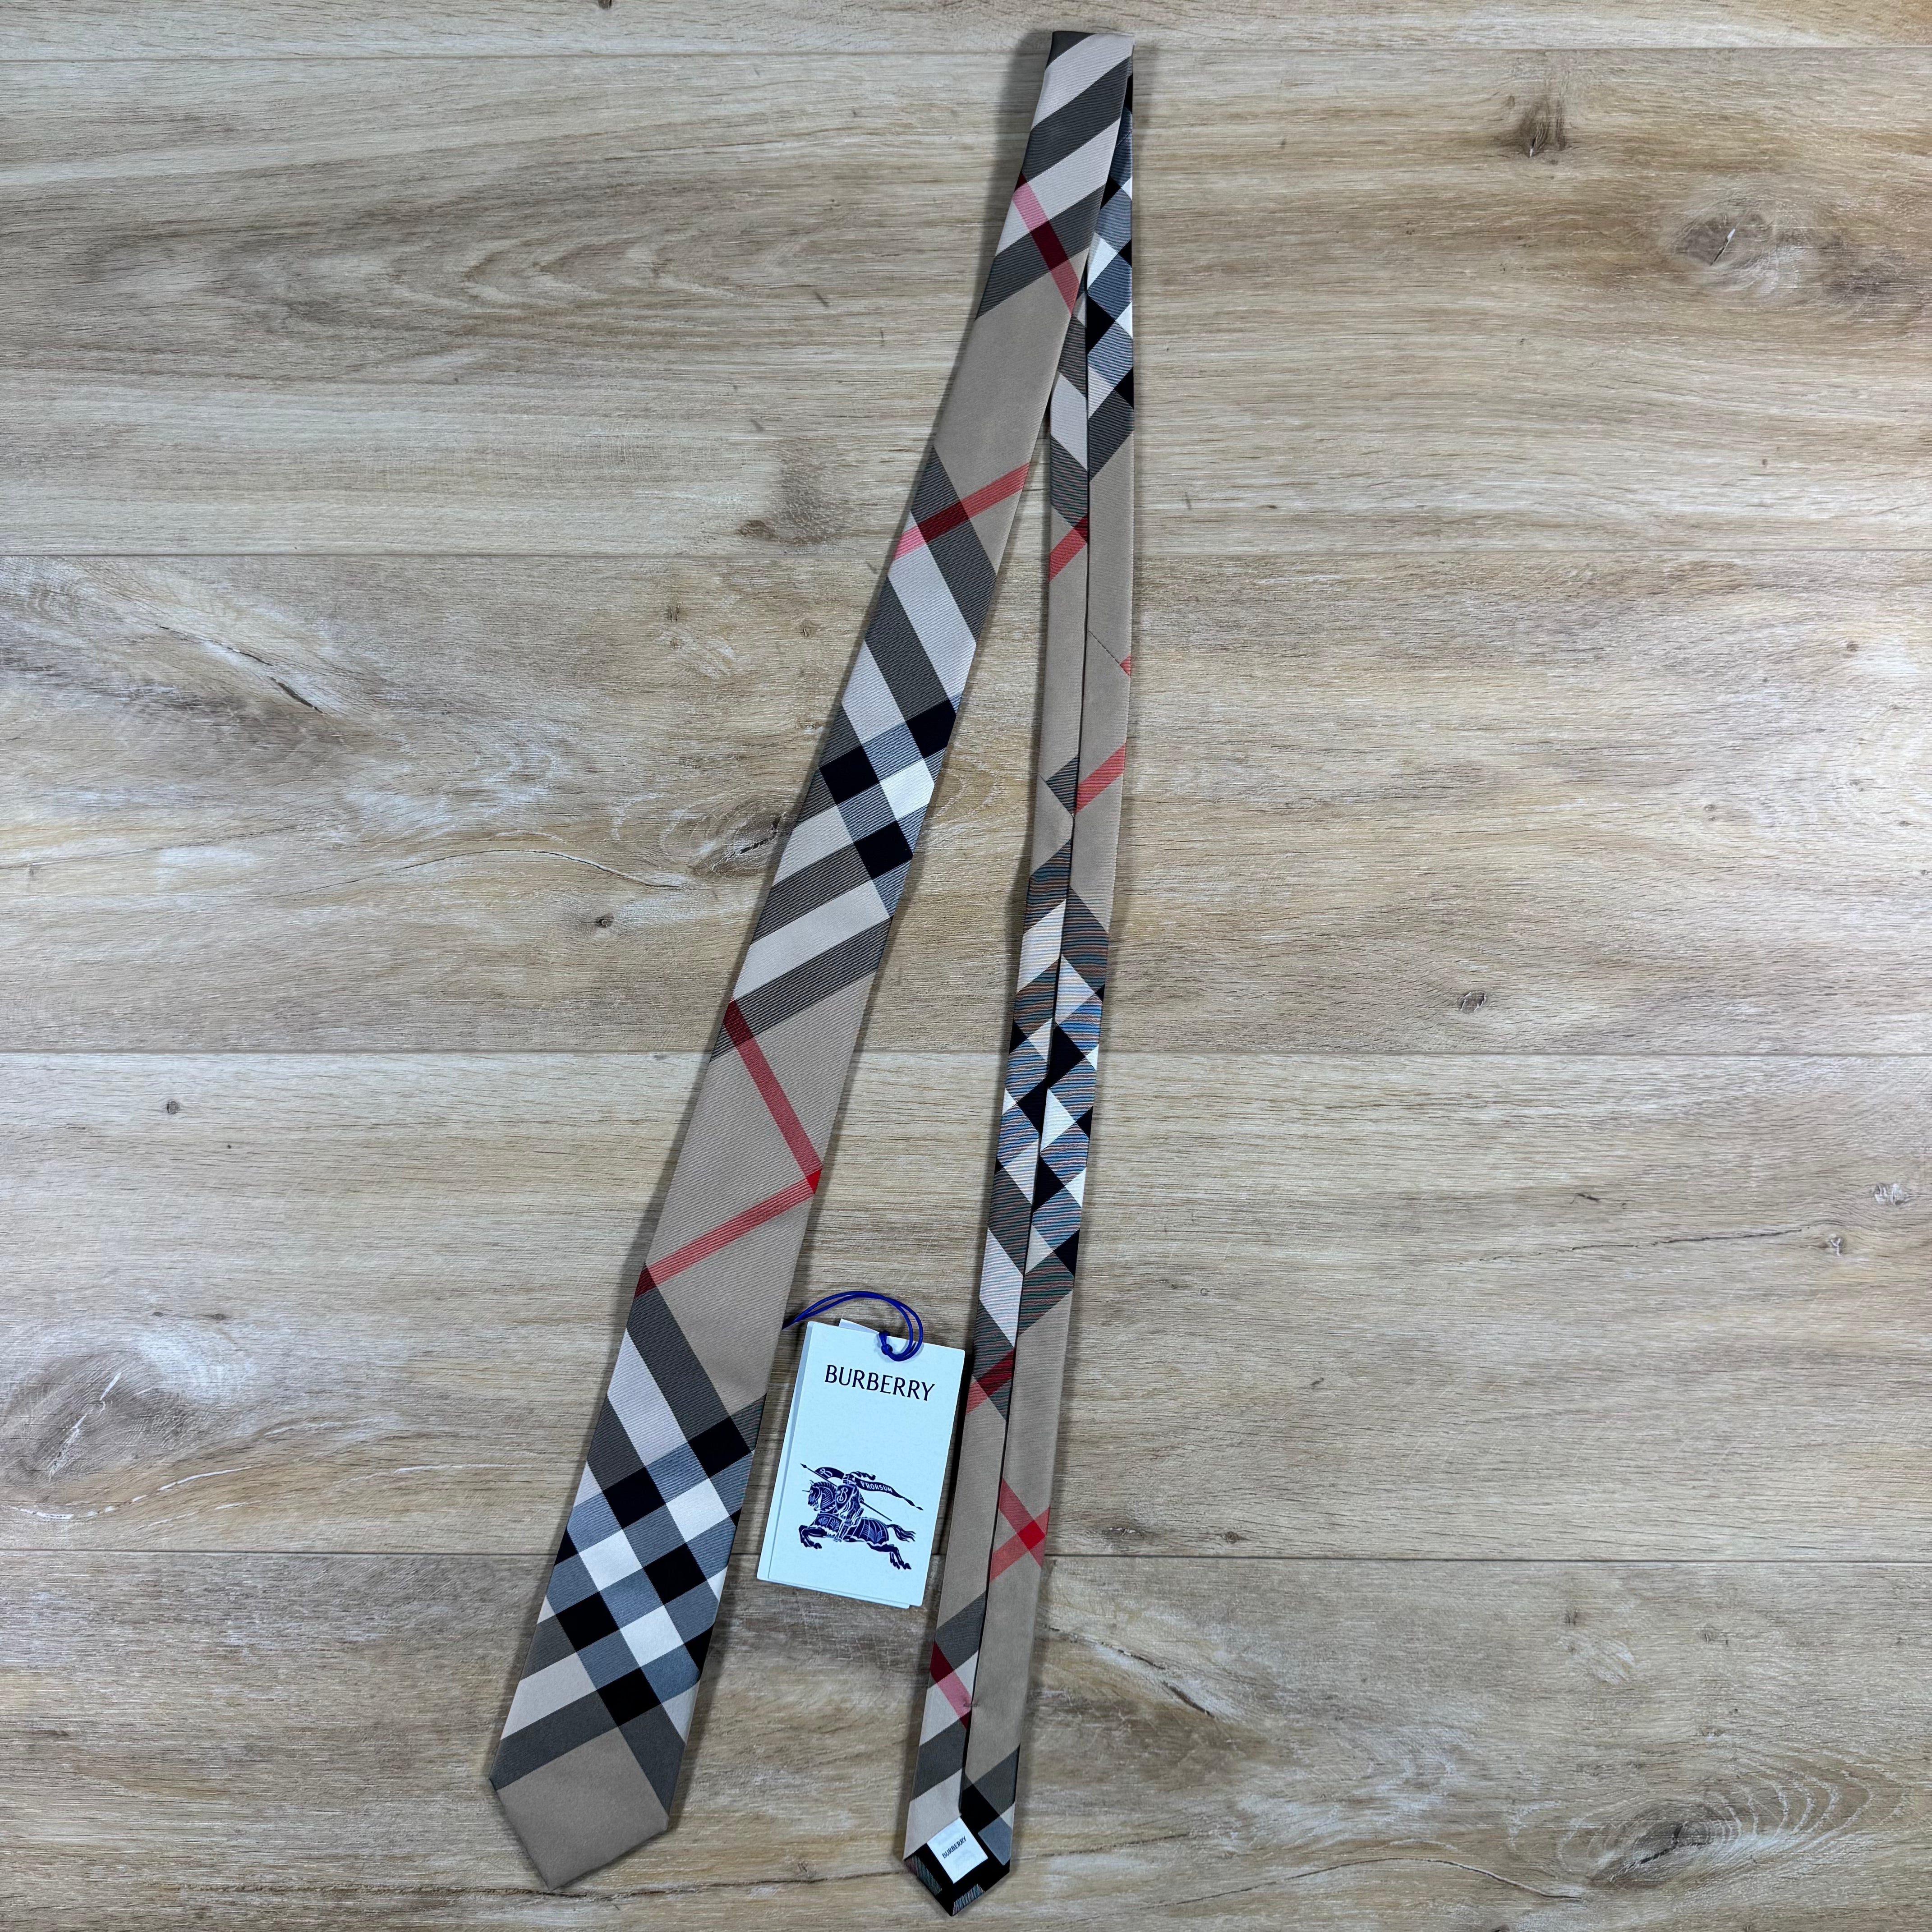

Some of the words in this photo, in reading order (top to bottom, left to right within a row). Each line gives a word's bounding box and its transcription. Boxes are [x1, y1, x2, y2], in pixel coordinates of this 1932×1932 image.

[824, 1365, 935, 1401] BURBERRY
[860, 1481, 892, 1493] PRORSUM
[942, 1835, 966, 1858] BURBERRY
